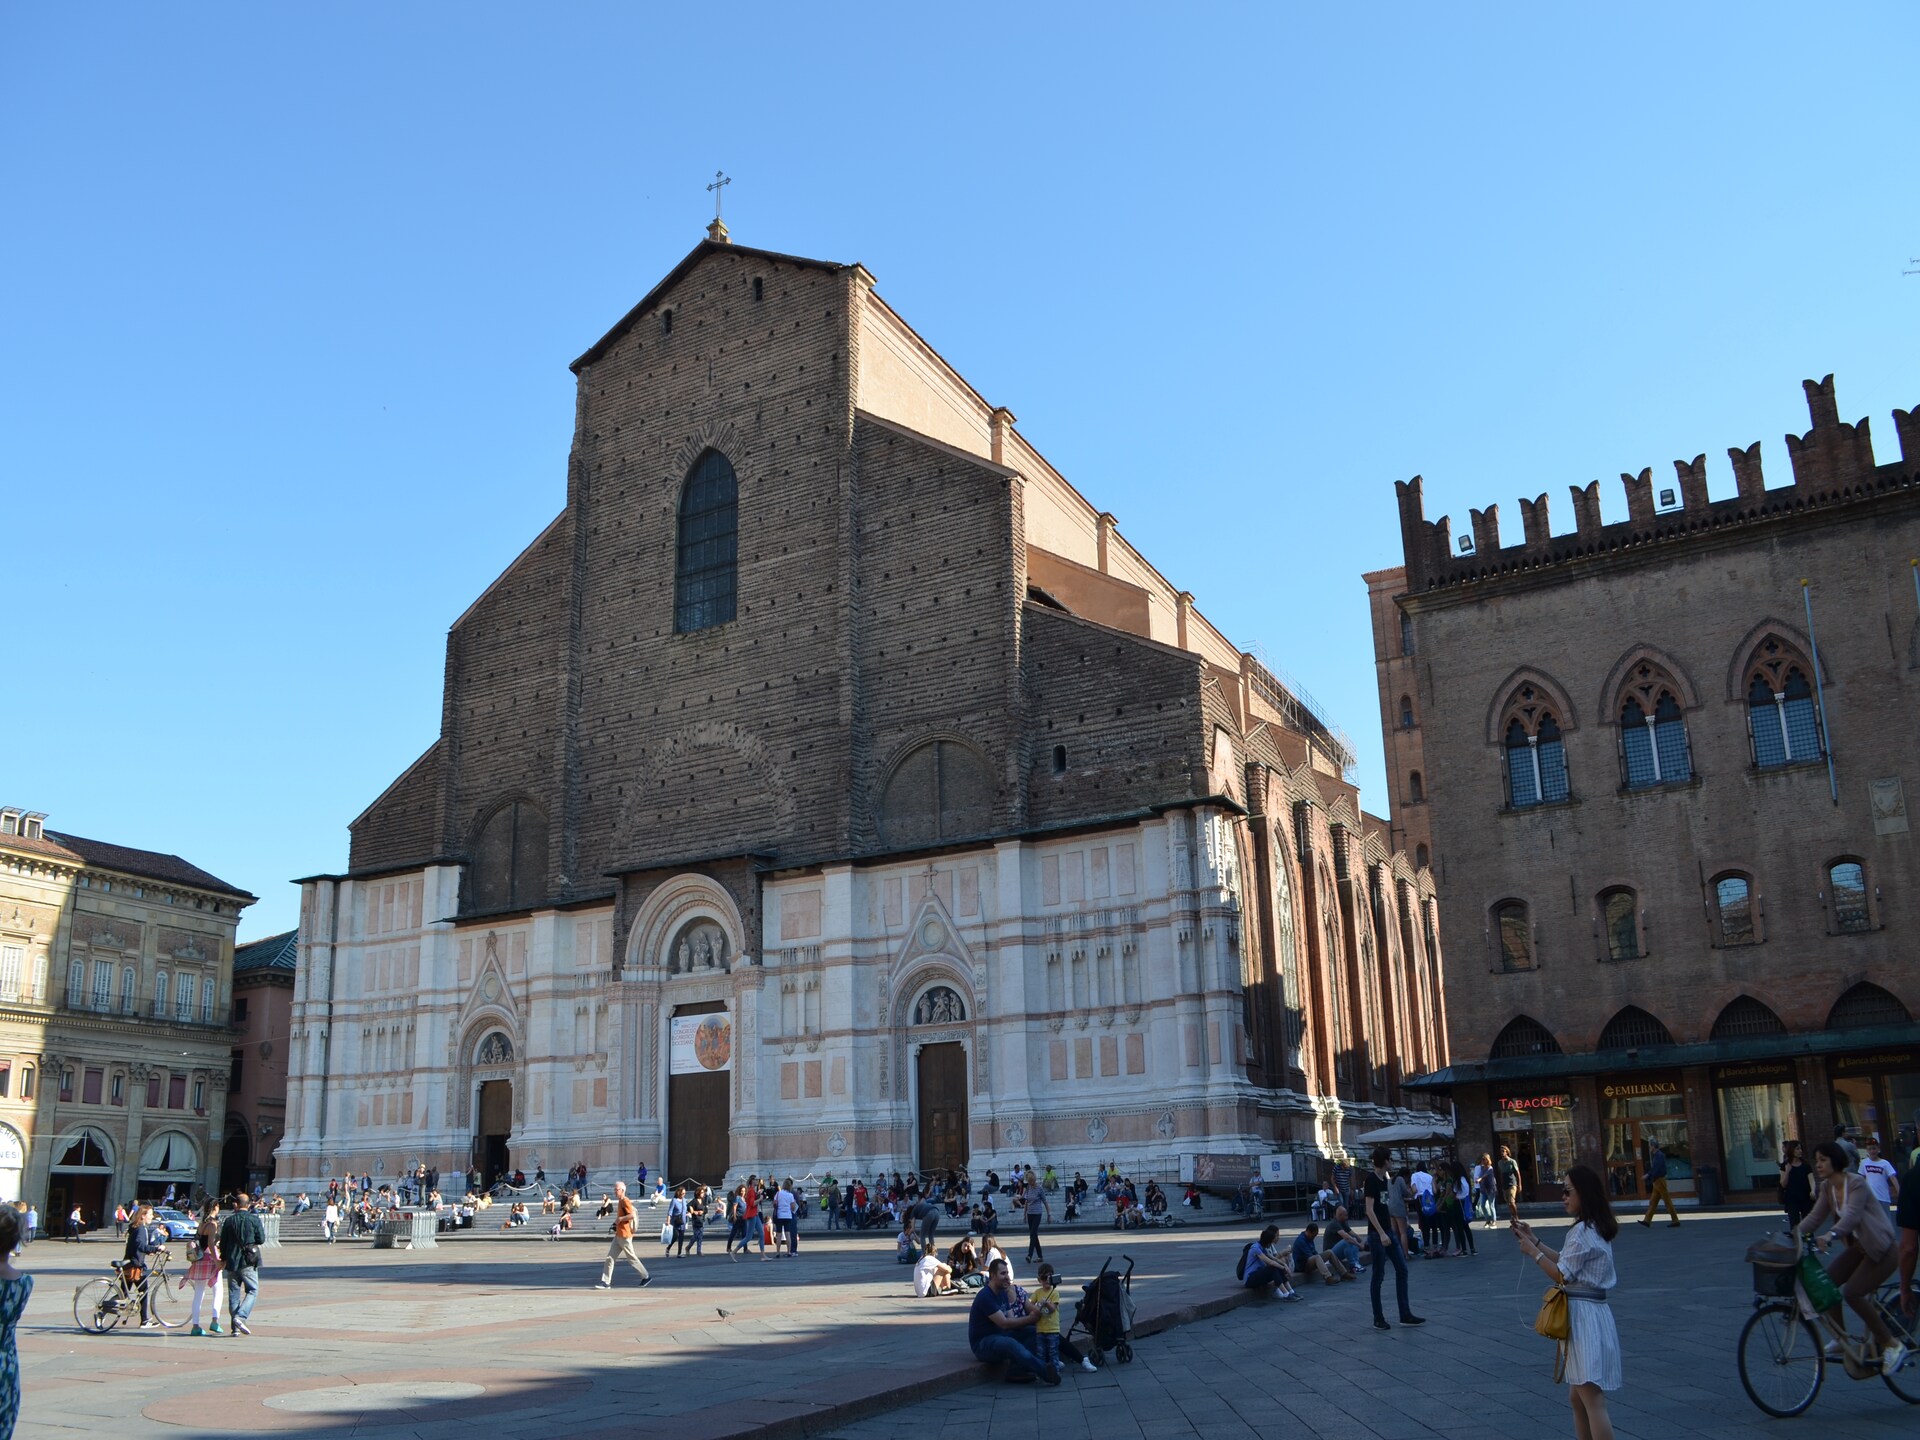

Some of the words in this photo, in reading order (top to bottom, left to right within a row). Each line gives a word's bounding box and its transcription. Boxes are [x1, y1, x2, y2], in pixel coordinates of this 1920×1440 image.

[1846, 1057, 1869, 1066] Banca
[1879, 1054, 1910, 1065] Bologna
[1726, 1068, 1748, 1076] Banca
[1757, 1064, 1788, 1074] Bologna
[1615, 1082, 1676, 1096] EMILBANCA
[1498, 1096, 1563, 1110] TABACCHI
